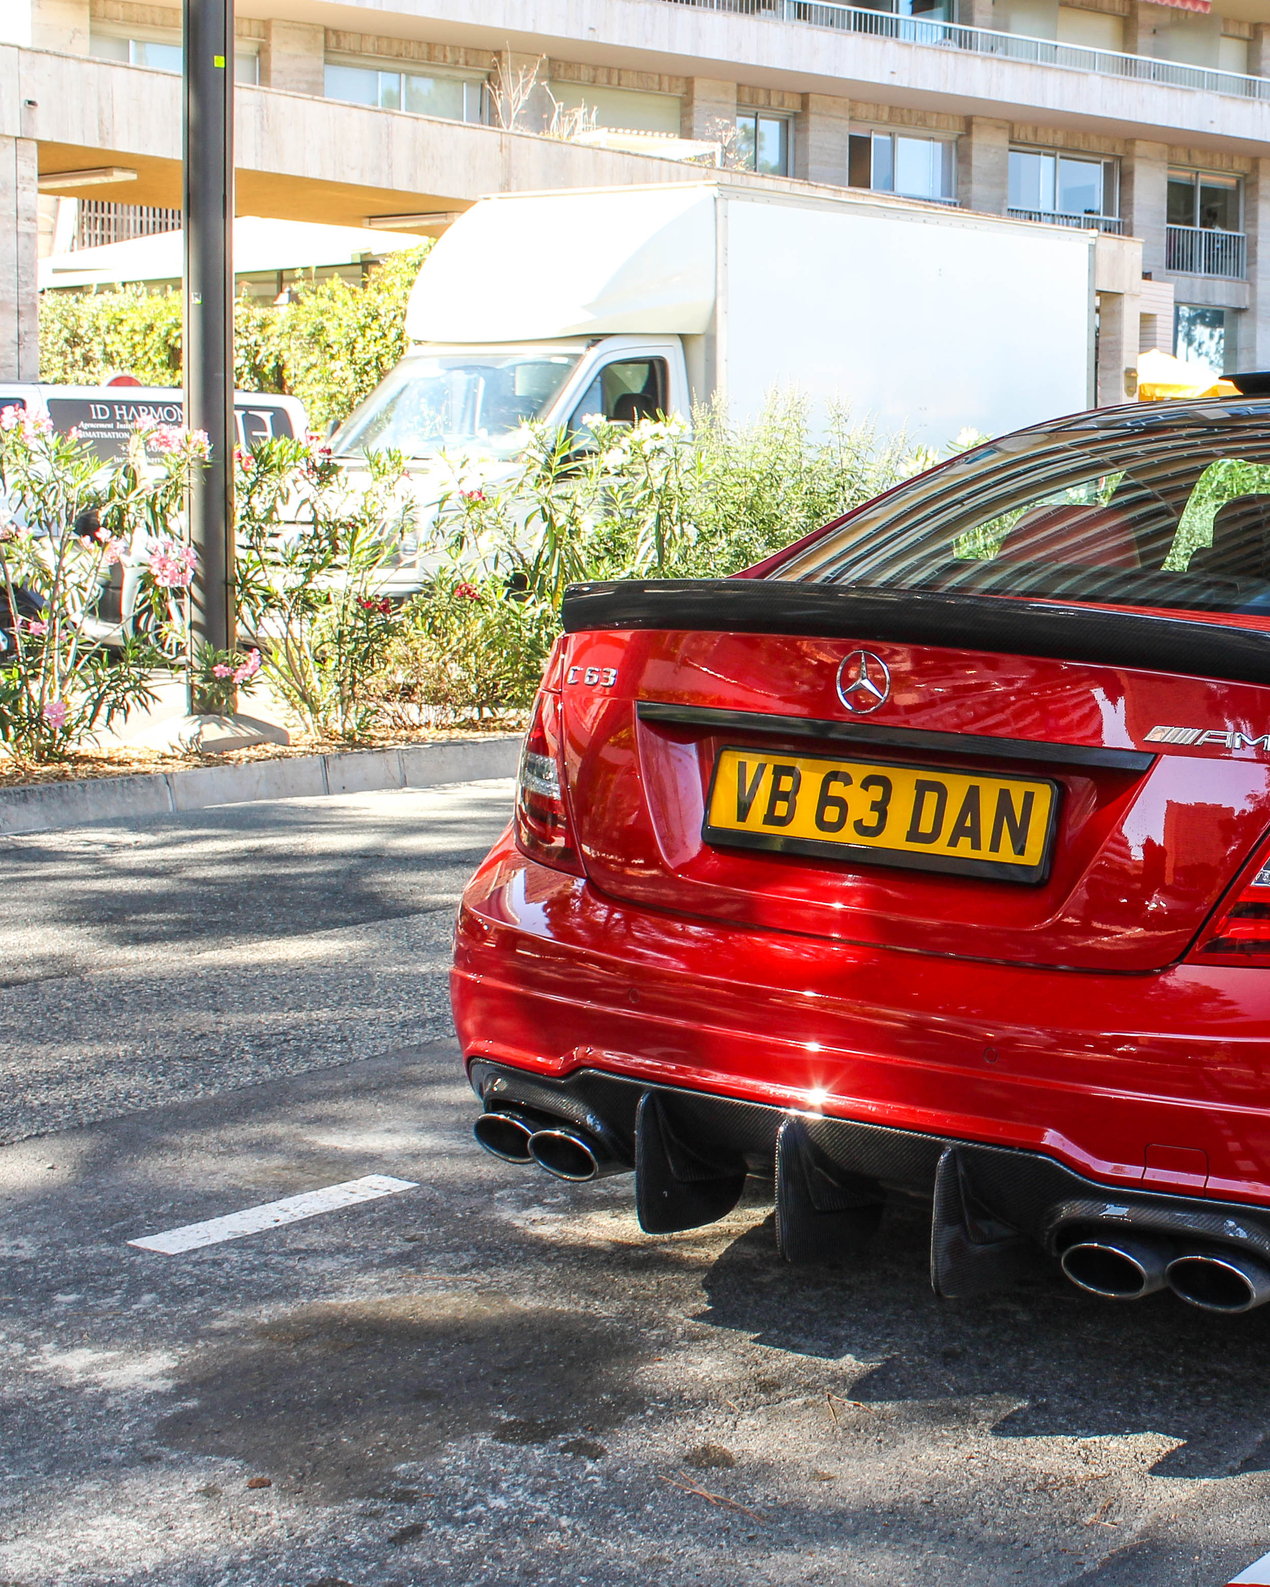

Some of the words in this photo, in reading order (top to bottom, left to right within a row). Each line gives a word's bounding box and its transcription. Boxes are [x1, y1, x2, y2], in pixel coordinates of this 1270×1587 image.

[90, 404, 111, 420] ID
[79, 421, 114, 430] Agencement
[567, 665, 584, 685] C
[584, 666, 618, 687] 63
[736, 761, 801, 827] VB
[815, 770, 893, 838] 63
[905, 779, 1035, 856] DAN
